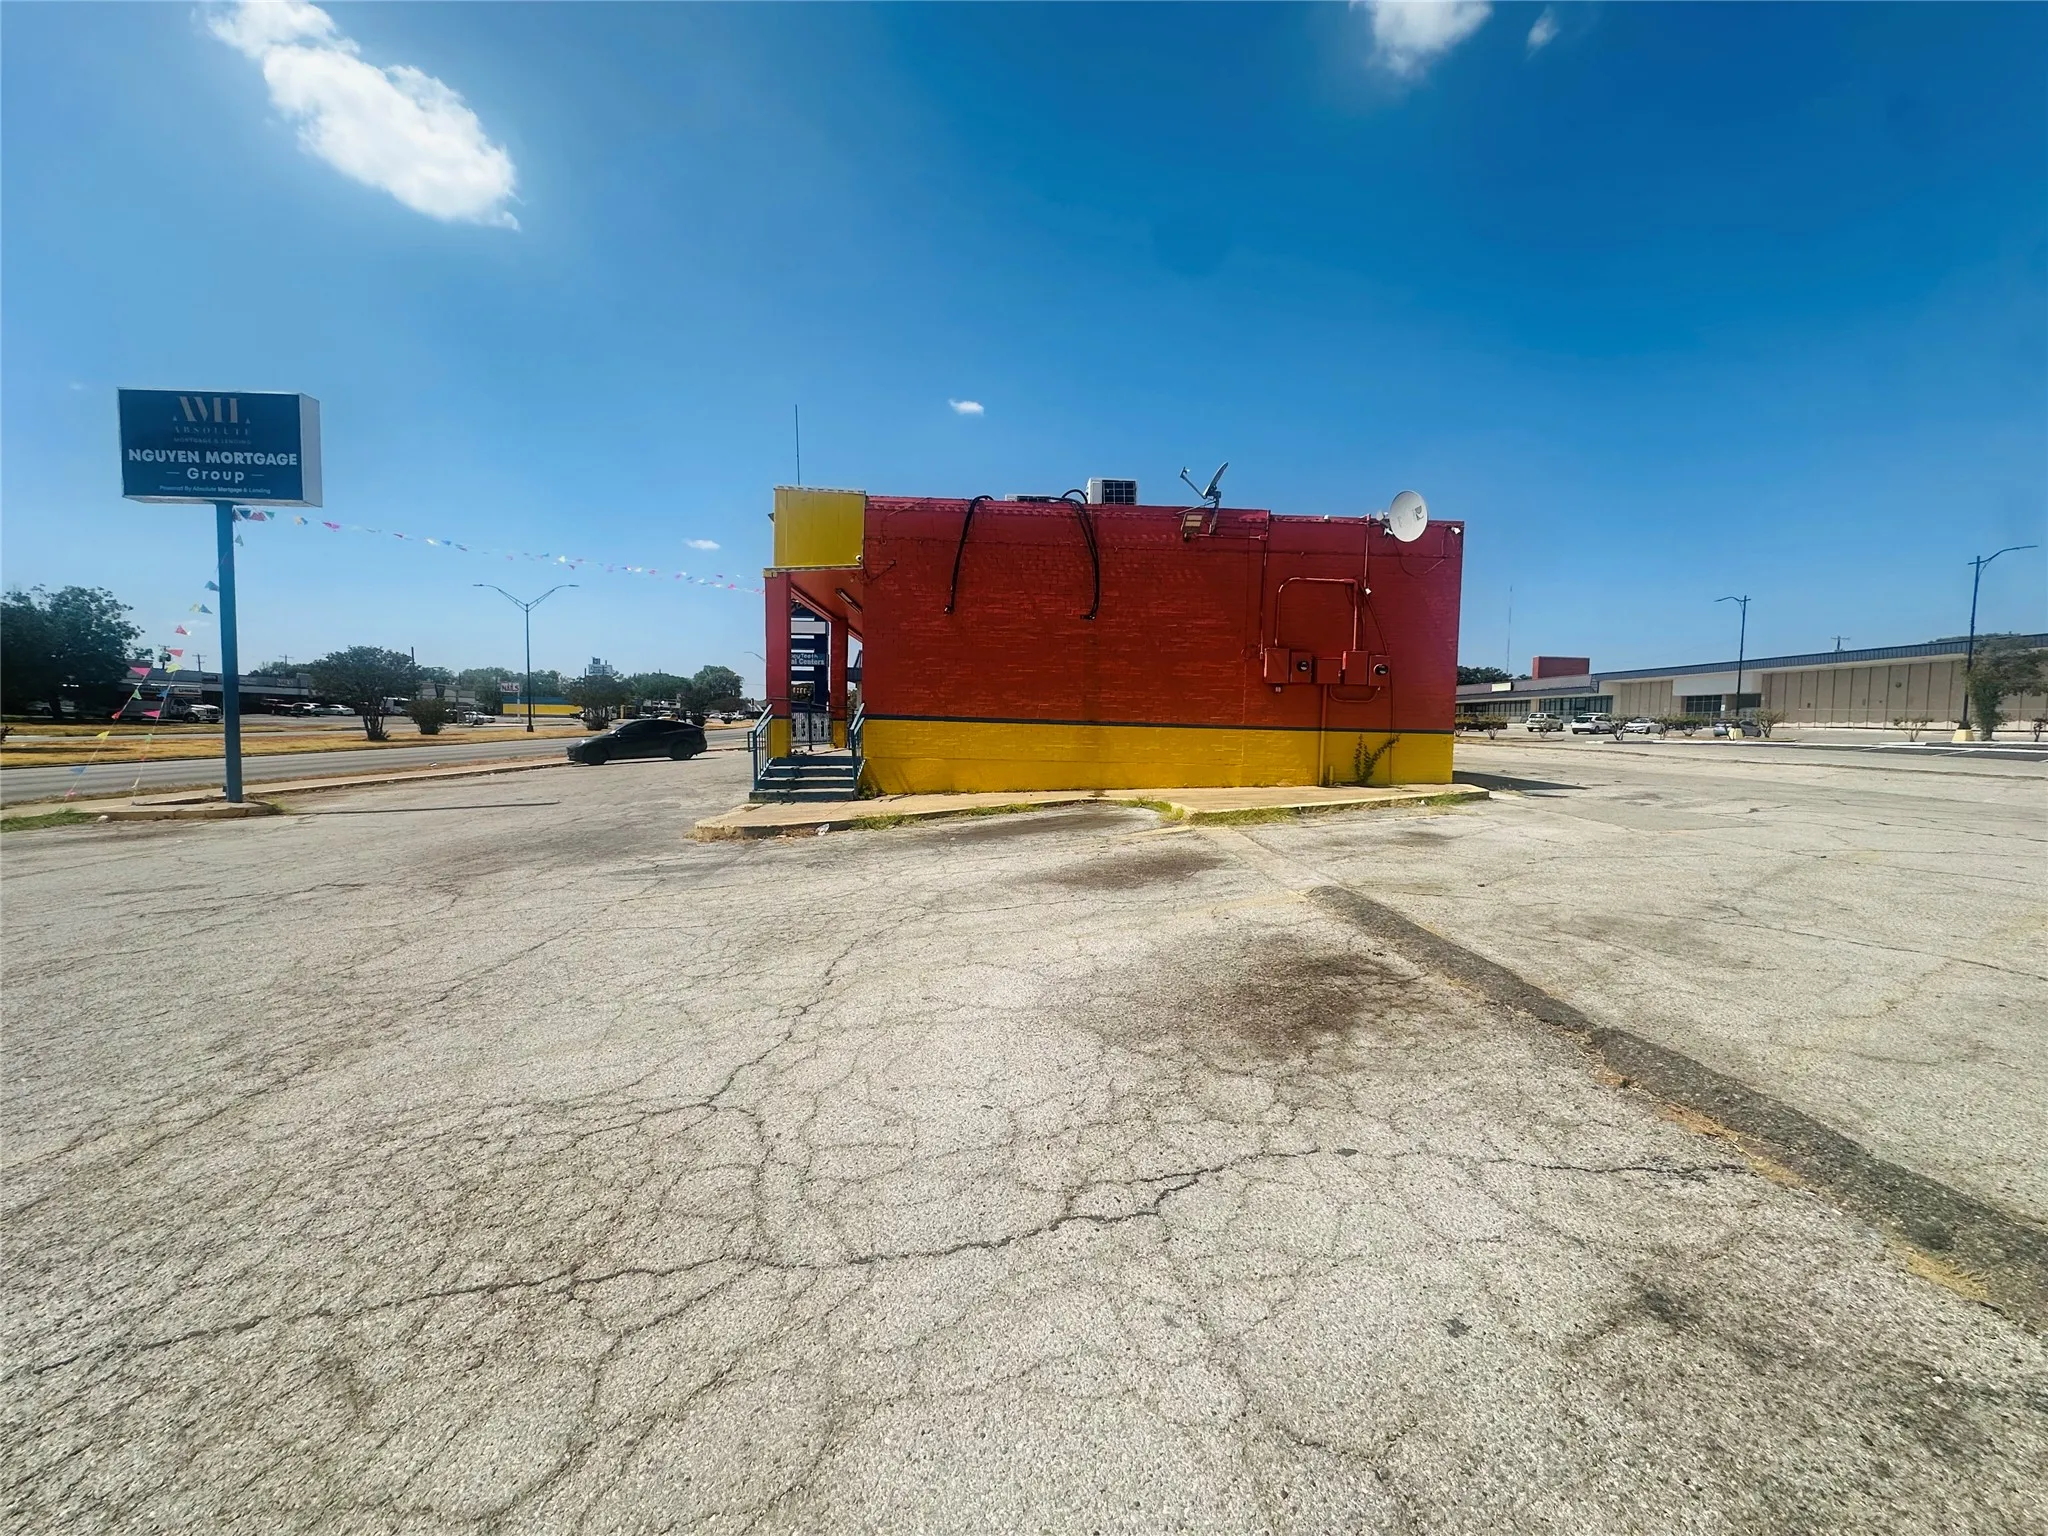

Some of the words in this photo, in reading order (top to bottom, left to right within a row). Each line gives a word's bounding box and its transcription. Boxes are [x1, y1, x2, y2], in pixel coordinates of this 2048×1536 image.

[174, 426, 250, 435] ABSOLUTE
[128, 448, 200, 463] NGUYEN
[207, 451, 298, 466] MORTGAGE
[187, 467, 245, 484] Group
